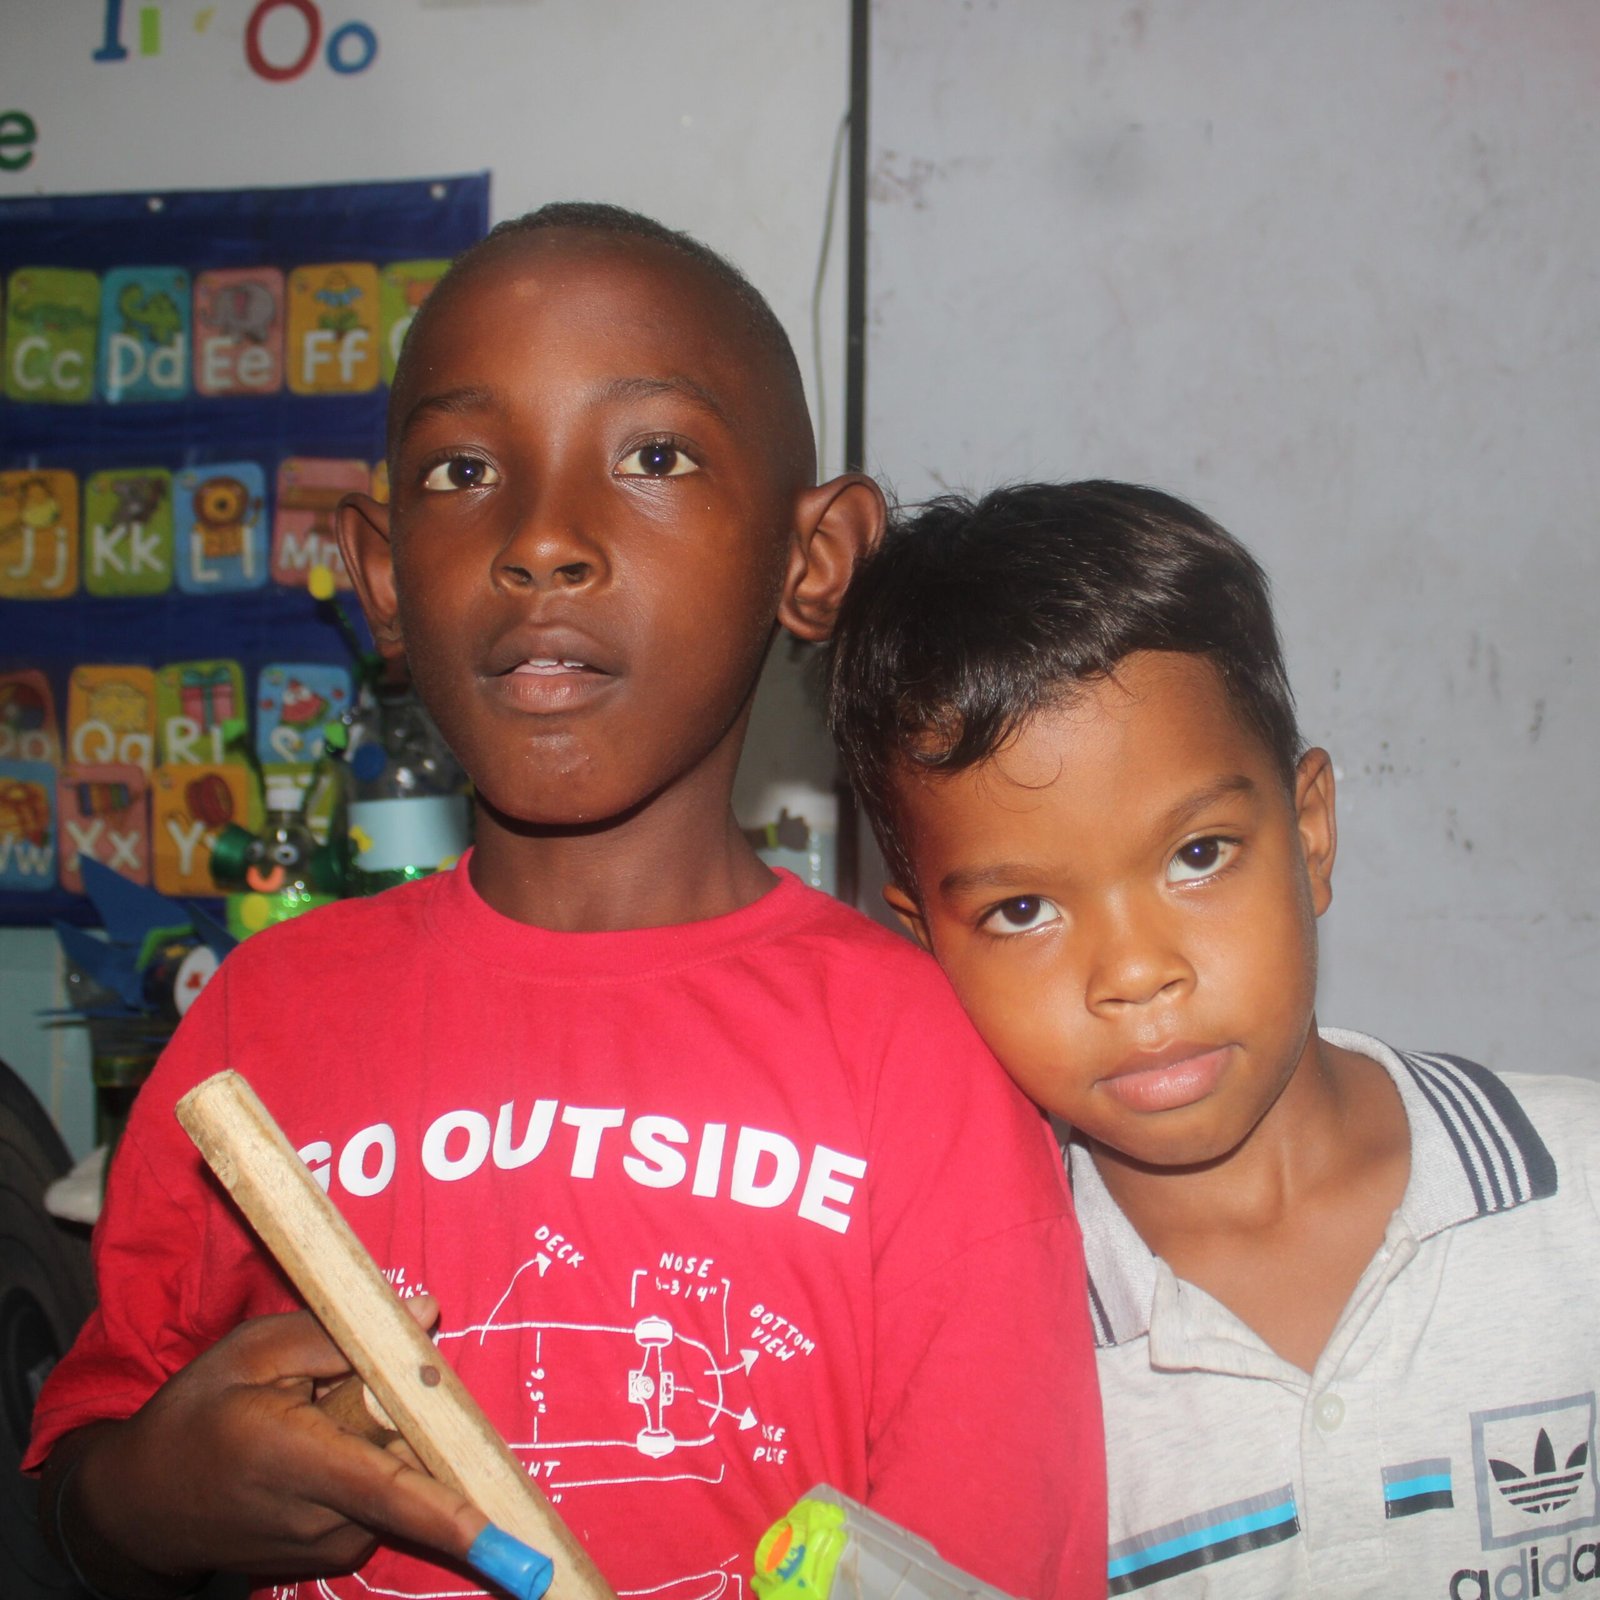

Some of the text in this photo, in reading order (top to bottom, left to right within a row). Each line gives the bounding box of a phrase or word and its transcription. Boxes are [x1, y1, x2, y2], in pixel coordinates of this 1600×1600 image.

[244, 0, 378, 83] Oo
[13, 337, 85, 391] Cc
[107, 332, 186, 390] Dd
[203, 337, 274, 389] Ee
[302, 330, 369, 384] Ff
[7, 527, 69, 589] Jj
[92, 521, 165, 577] Kk
[191, 524, 256, 582] Ll
[296, 1100, 867, 1234] GO OUTSIDE
[534, 1225, 585, 1268] DECK
[659, 1252, 714, 1278] NOSE
[750, 1304, 815, 1356] BOTTOM
[751, 1327, 796, 1362] VIEW
